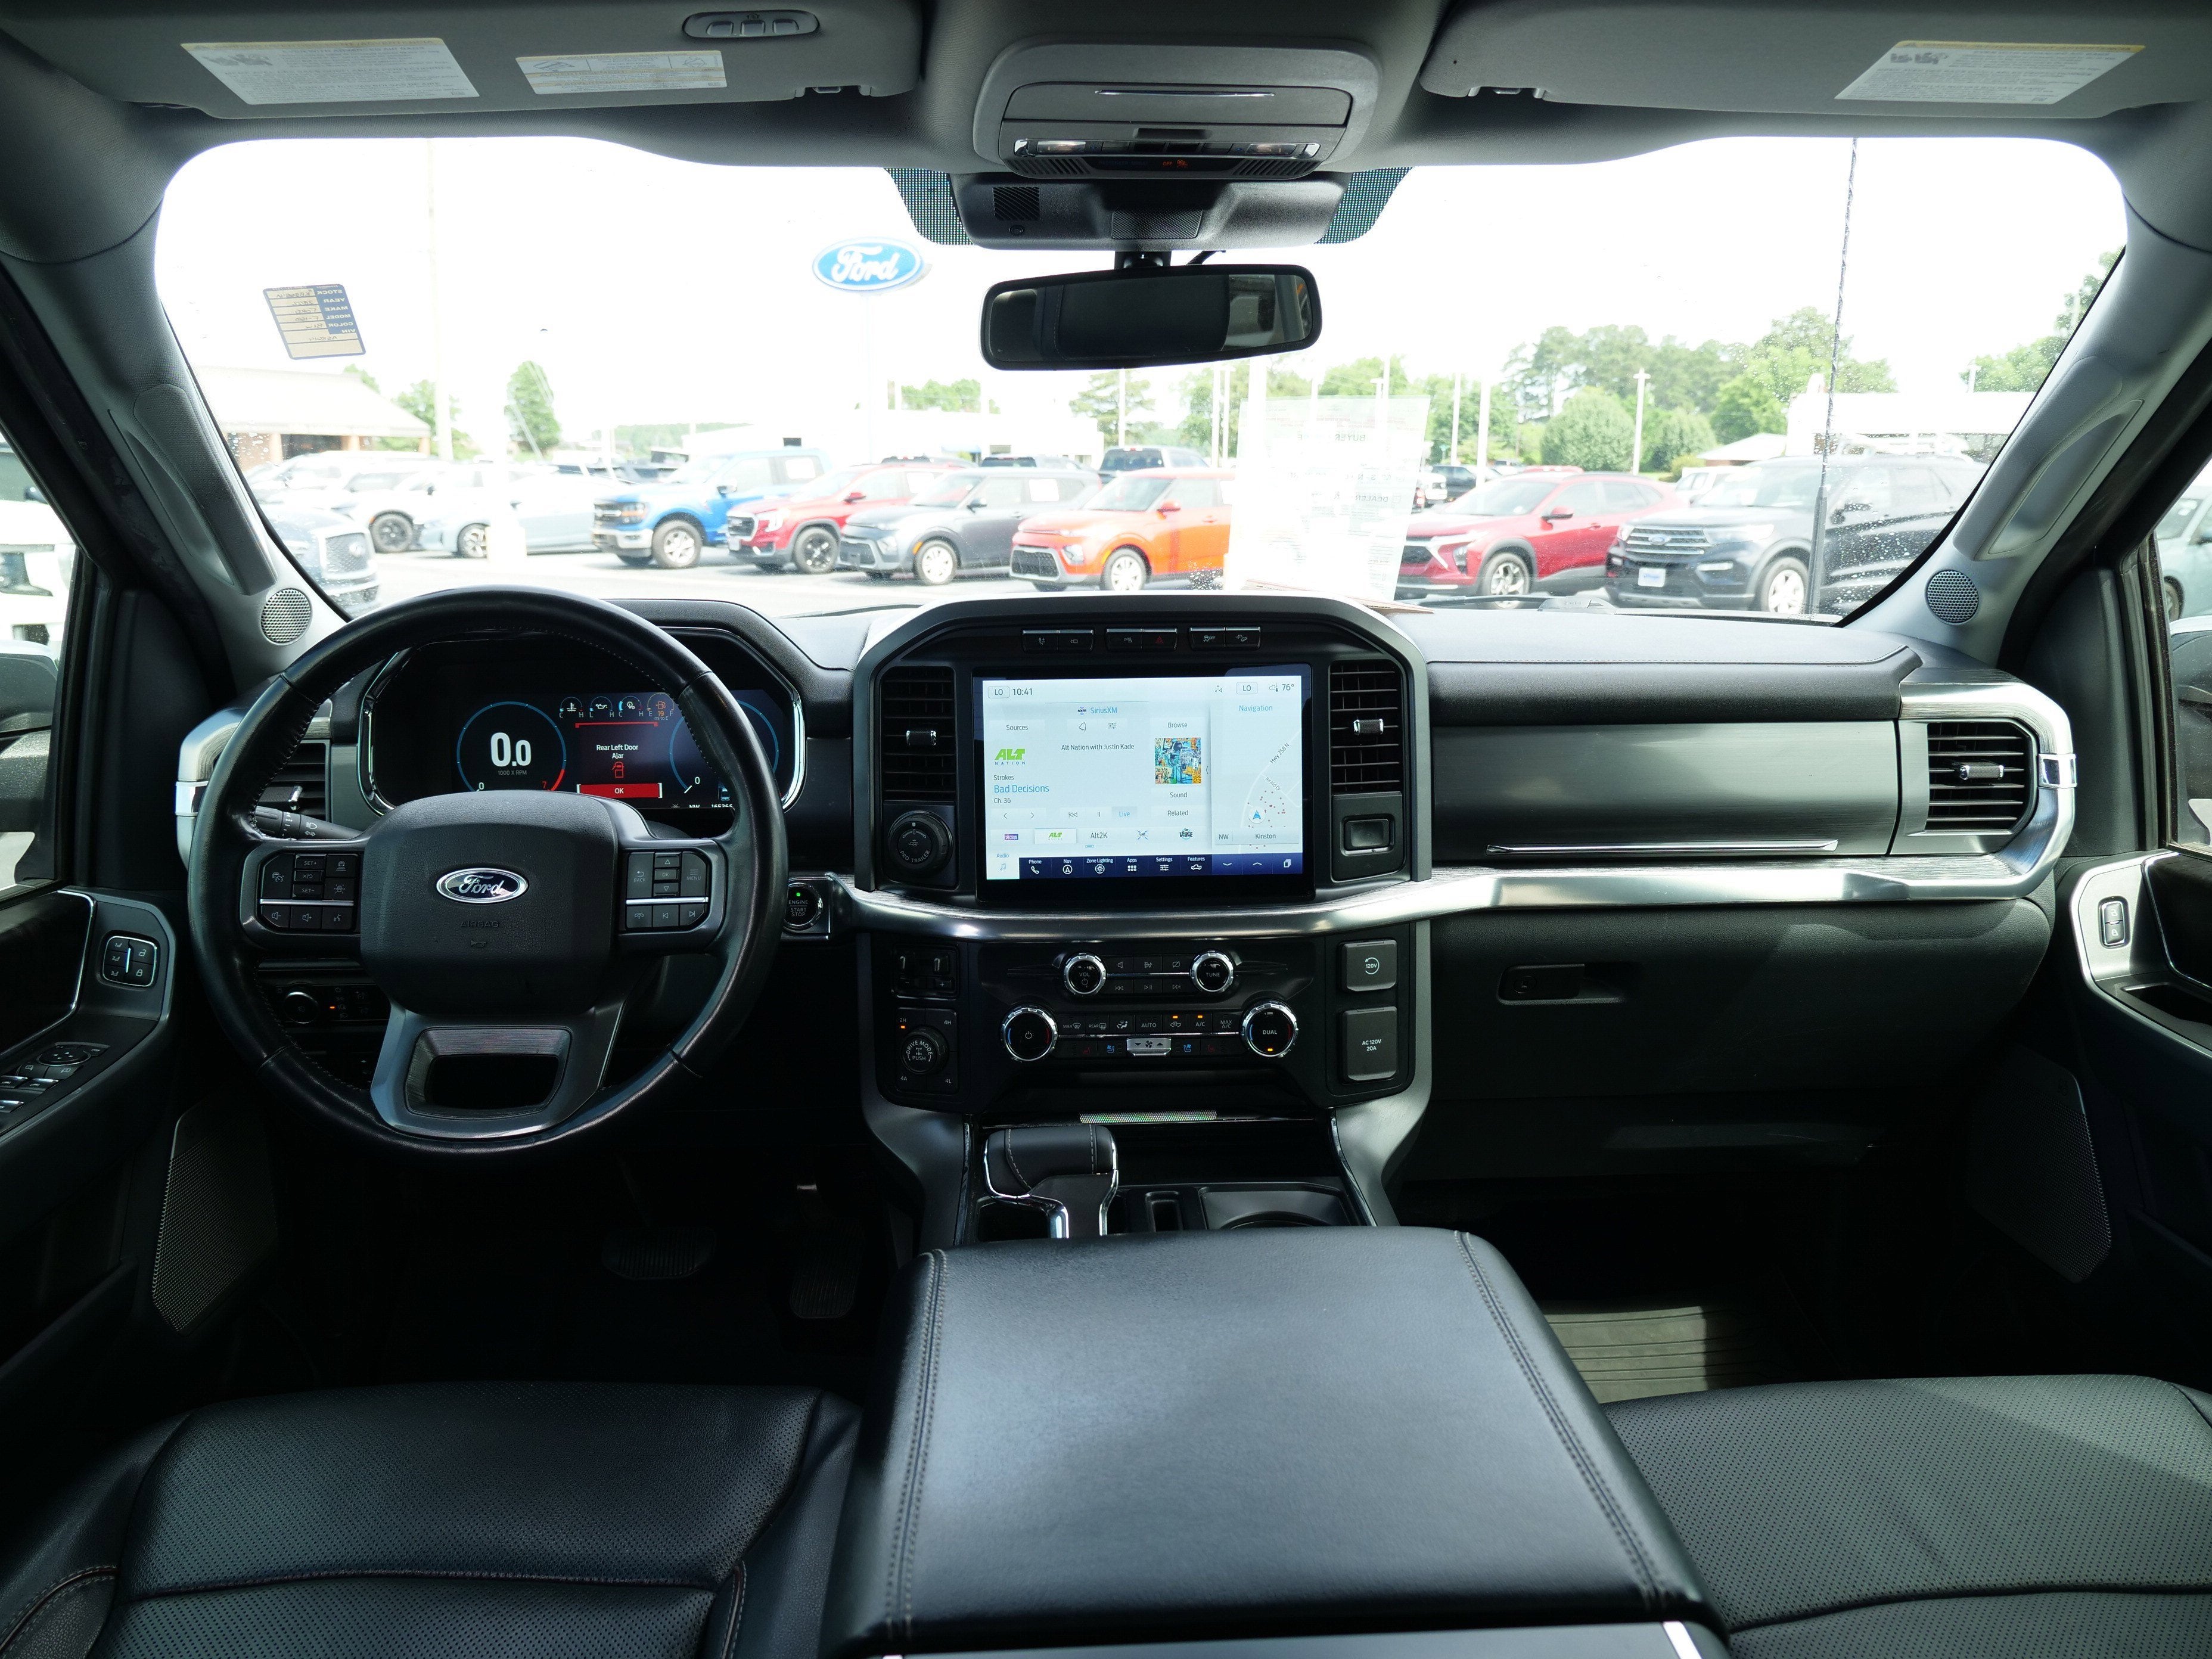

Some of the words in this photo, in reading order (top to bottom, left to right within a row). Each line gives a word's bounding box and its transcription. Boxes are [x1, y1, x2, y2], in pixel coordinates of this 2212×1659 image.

[831, 246, 900, 282] Ford
[490, 732, 532, 767] 0.0
[995, 748, 1026, 760] ALT
[1270, 754, 1280, 764] Hwy
[479, 782, 484, 790] 0
[994, 785, 1010, 793] Bad
[1012, 784, 1049, 793] Decisions
[900, 850, 909, 861] PRO
[911, 850, 931, 863] TRAILER
[459, 874, 505, 896] Ford
[906, 1040, 918, 1054] DRIVE
[919, 1040, 933, 1055] MODE
